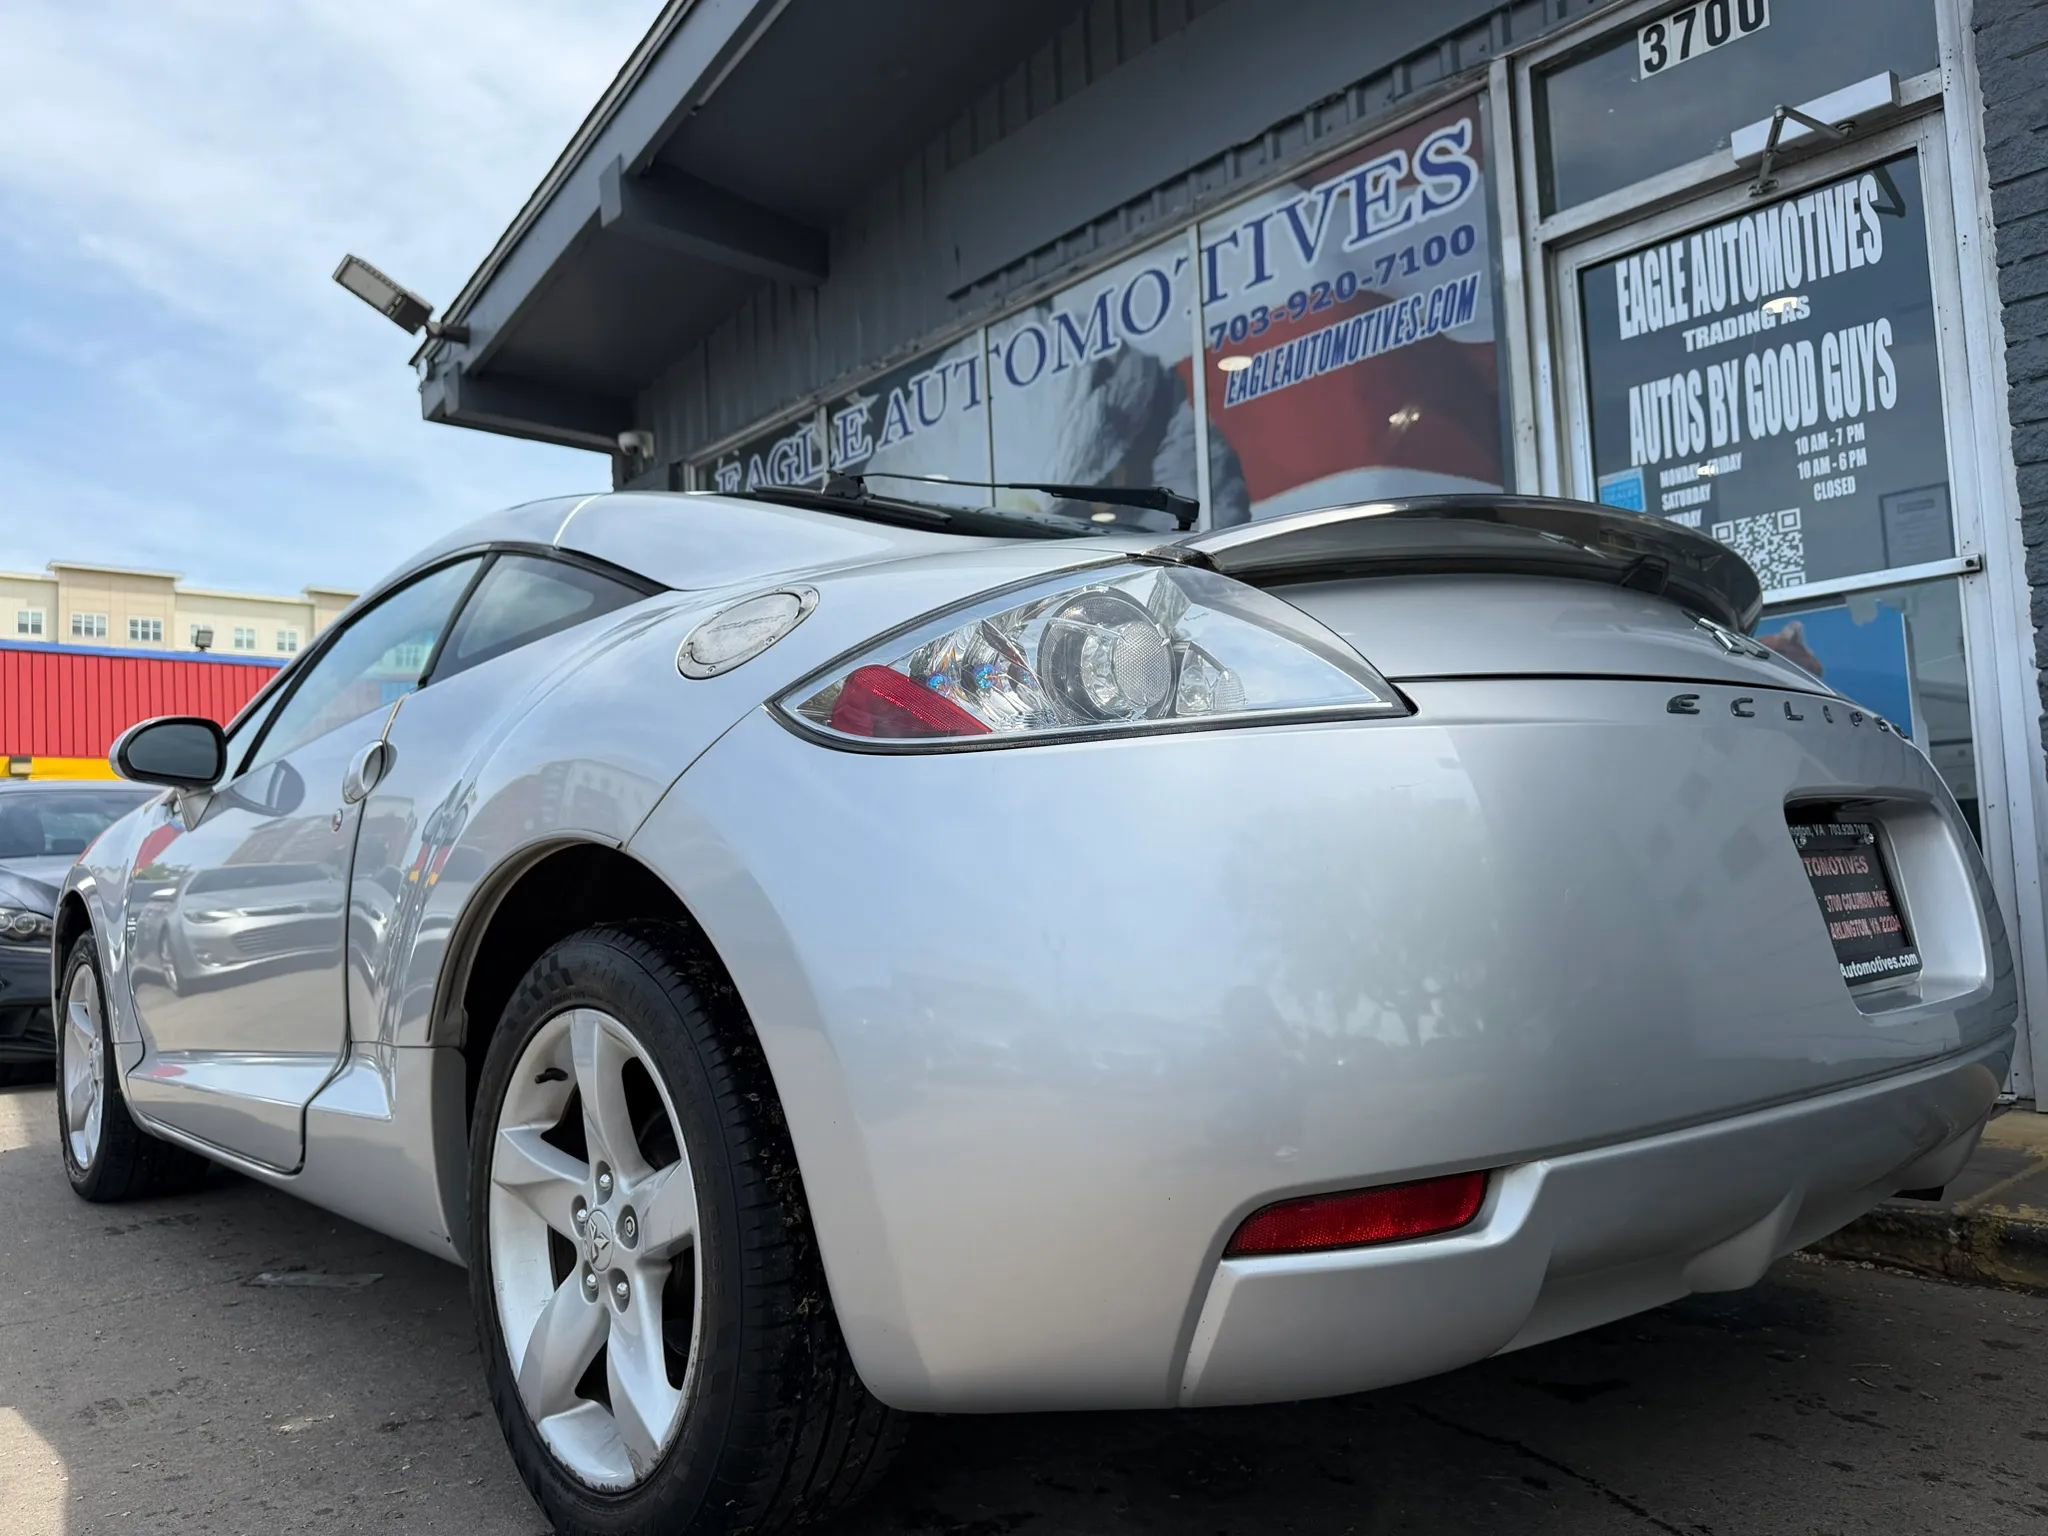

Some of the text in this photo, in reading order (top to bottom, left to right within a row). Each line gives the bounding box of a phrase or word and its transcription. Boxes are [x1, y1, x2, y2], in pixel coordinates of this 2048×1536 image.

[1642, 0, 1765, 73] 3700
[1210, 224, 1476, 351] 703-920-7100
[1615, 174, 1883, 340] EAGLE AUTOMOTIVES
[716, 117, 1479, 493] EAGLE AUTOMOTIVES
[1682, 296, 1811, 352] TRADING AS
[1224, 270, 1482, 409] EAGLEAUTOMOTIVES.COM
[1628, 317, 1898, 467] AUTOS BY GOOD GUYS
[1659, 452, 1742, 488] MONDAY FRIDAY
[1795, 436, 1809, 455] 10
[1810, 431, 1829, 452] AM
[1835, 427, 1842, 446] 7
[1846, 422, 1866, 444] PM
[1796, 460, 1811, 480] 10
[1812, 455, 1831, 477] AM
[1838, 452, 1848, 471] 6
[1848, 447, 1868, 469] PM
[1661, 483, 1711, 511] SATURDAY
[1813, 475, 1856, 501] CLOSED
